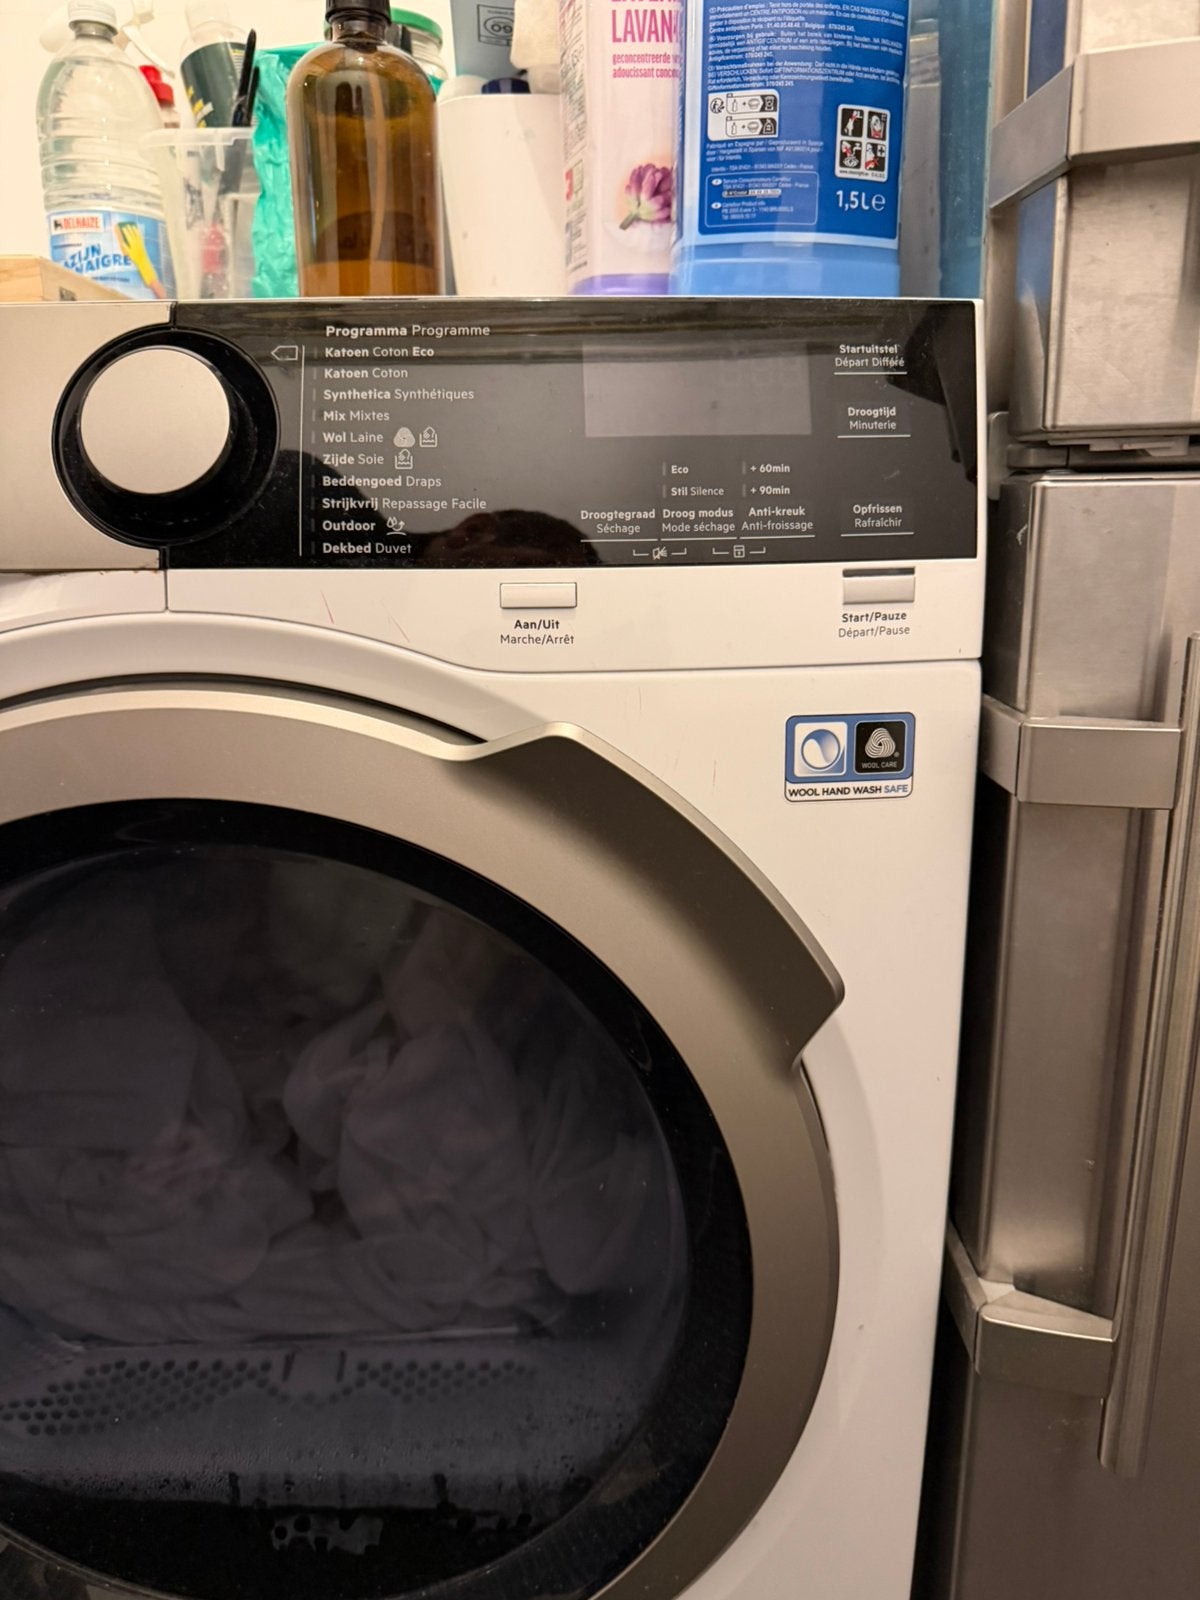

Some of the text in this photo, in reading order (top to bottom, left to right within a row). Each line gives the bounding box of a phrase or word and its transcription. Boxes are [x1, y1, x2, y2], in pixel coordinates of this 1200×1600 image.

[613, 52, 671, 65] geconcentreerde
[613, 66, 655, 78] adoucissant
[326, 324, 490, 339] Programma Programme
[325, 346, 434, 358] Katoen Coton Eco
[839, 344, 898, 354] Startuitstel
[834, 356, 905, 368] Départ Différé
[324, 368, 408, 379] Katoen Coton
[323, 388, 475, 402] Synthetica Synthétiques
[323, 410, 390, 421] Mix Mixtes
[848, 406, 897, 418] Droogtijd
[849, 420, 897, 430] Minuterie
[322, 432, 384, 443] Wol Laine
[322, 453, 384, 466] Zijde Soie
[670, 465, 689, 474] Eco
[759, 464, 791, 473] 60min
[322, 476, 442, 488] Beddengoed Draps
[670, 486, 724, 496] Stil Silence
[758, 486, 791, 495] 90min
[322, 498, 487, 511] Strijkvrij Repassage Facile
[852, 504, 902, 516] Opfrissen
[580, 508, 656, 522] Droogtegraad
[662, 508, 734, 520] Droog modus
[748, 506, 806, 518] Anti-kreuk
[322, 520, 376, 532] Outdoor
[596, 522, 641, 535] Séchage
[662, 522, 736, 534] Mode séchage
[741, 520, 814, 532] Anti-froissage
[854, 517, 902, 528] Rafraîchir
[322, 542, 412, 554] Dekbed Duvet
[842, 612, 907, 623] Start/Pauze
[514, 619, 560, 630] Aan/Uit
[838, 626, 910, 639] Départ/Pause
[500, 634, 574, 645] Marche/Arrêt
[880, 760, 898, 768] CARE
[788, 784, 909, 797] WOOL HAND WASH SAFE
